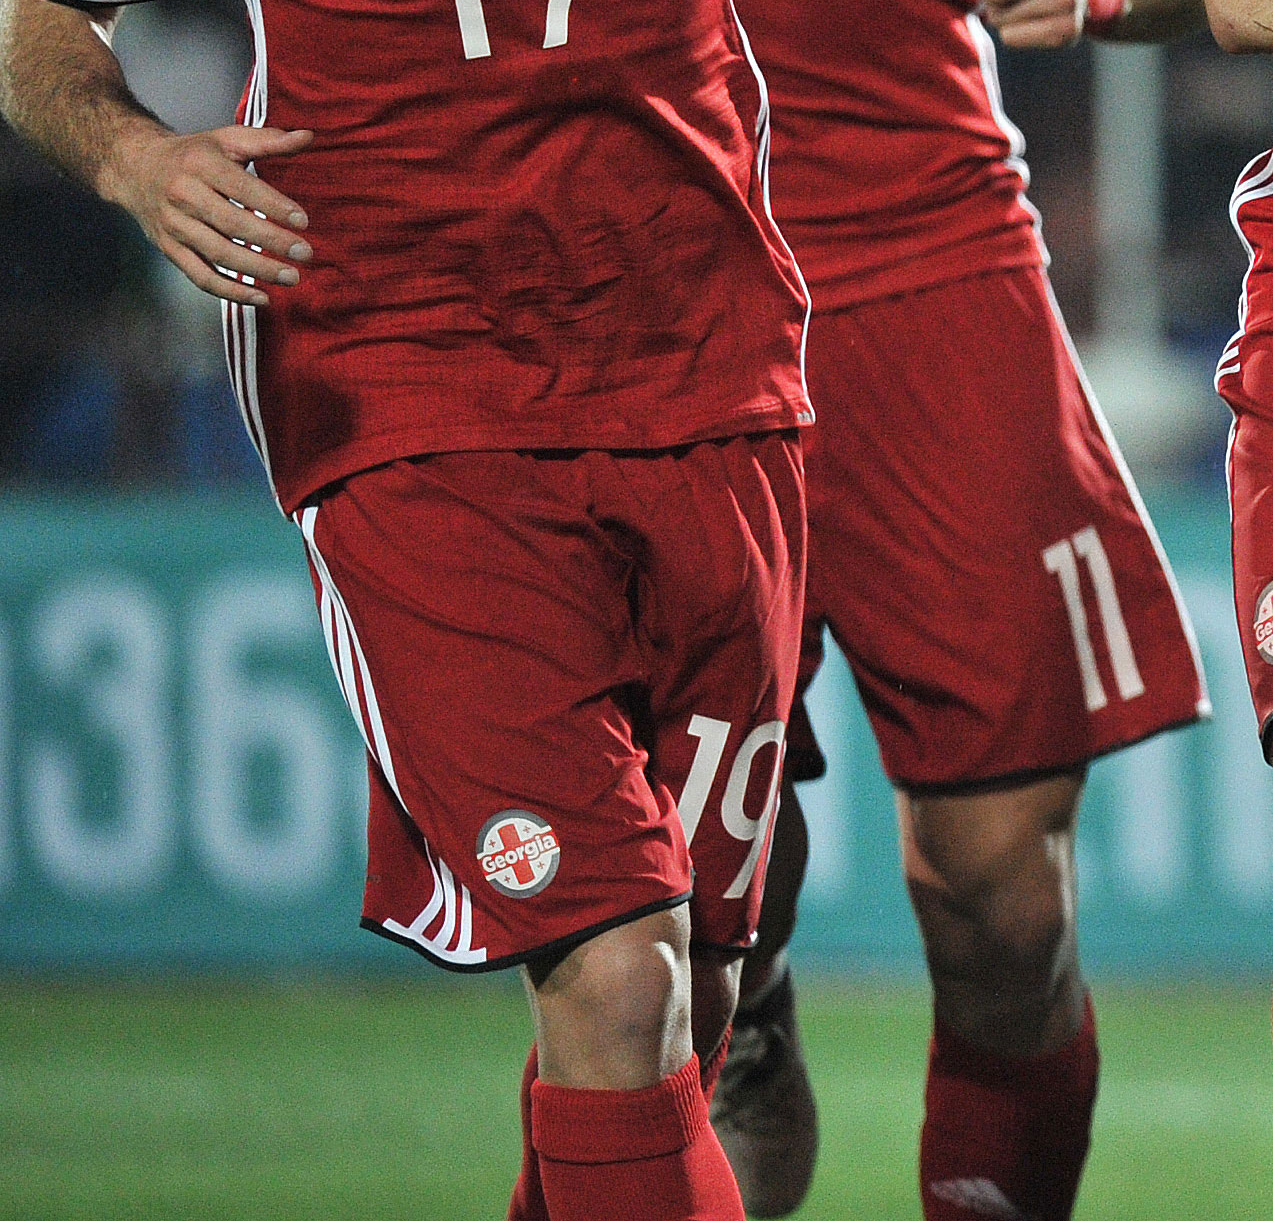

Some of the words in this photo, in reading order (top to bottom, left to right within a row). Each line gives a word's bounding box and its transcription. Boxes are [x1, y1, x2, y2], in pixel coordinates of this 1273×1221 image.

[1042, 525, 1146, 713] 11
[0, 574, 342, 901] 36
[676, 713, 786, 900] 19
[480, 832, 559, 877] Georgia
